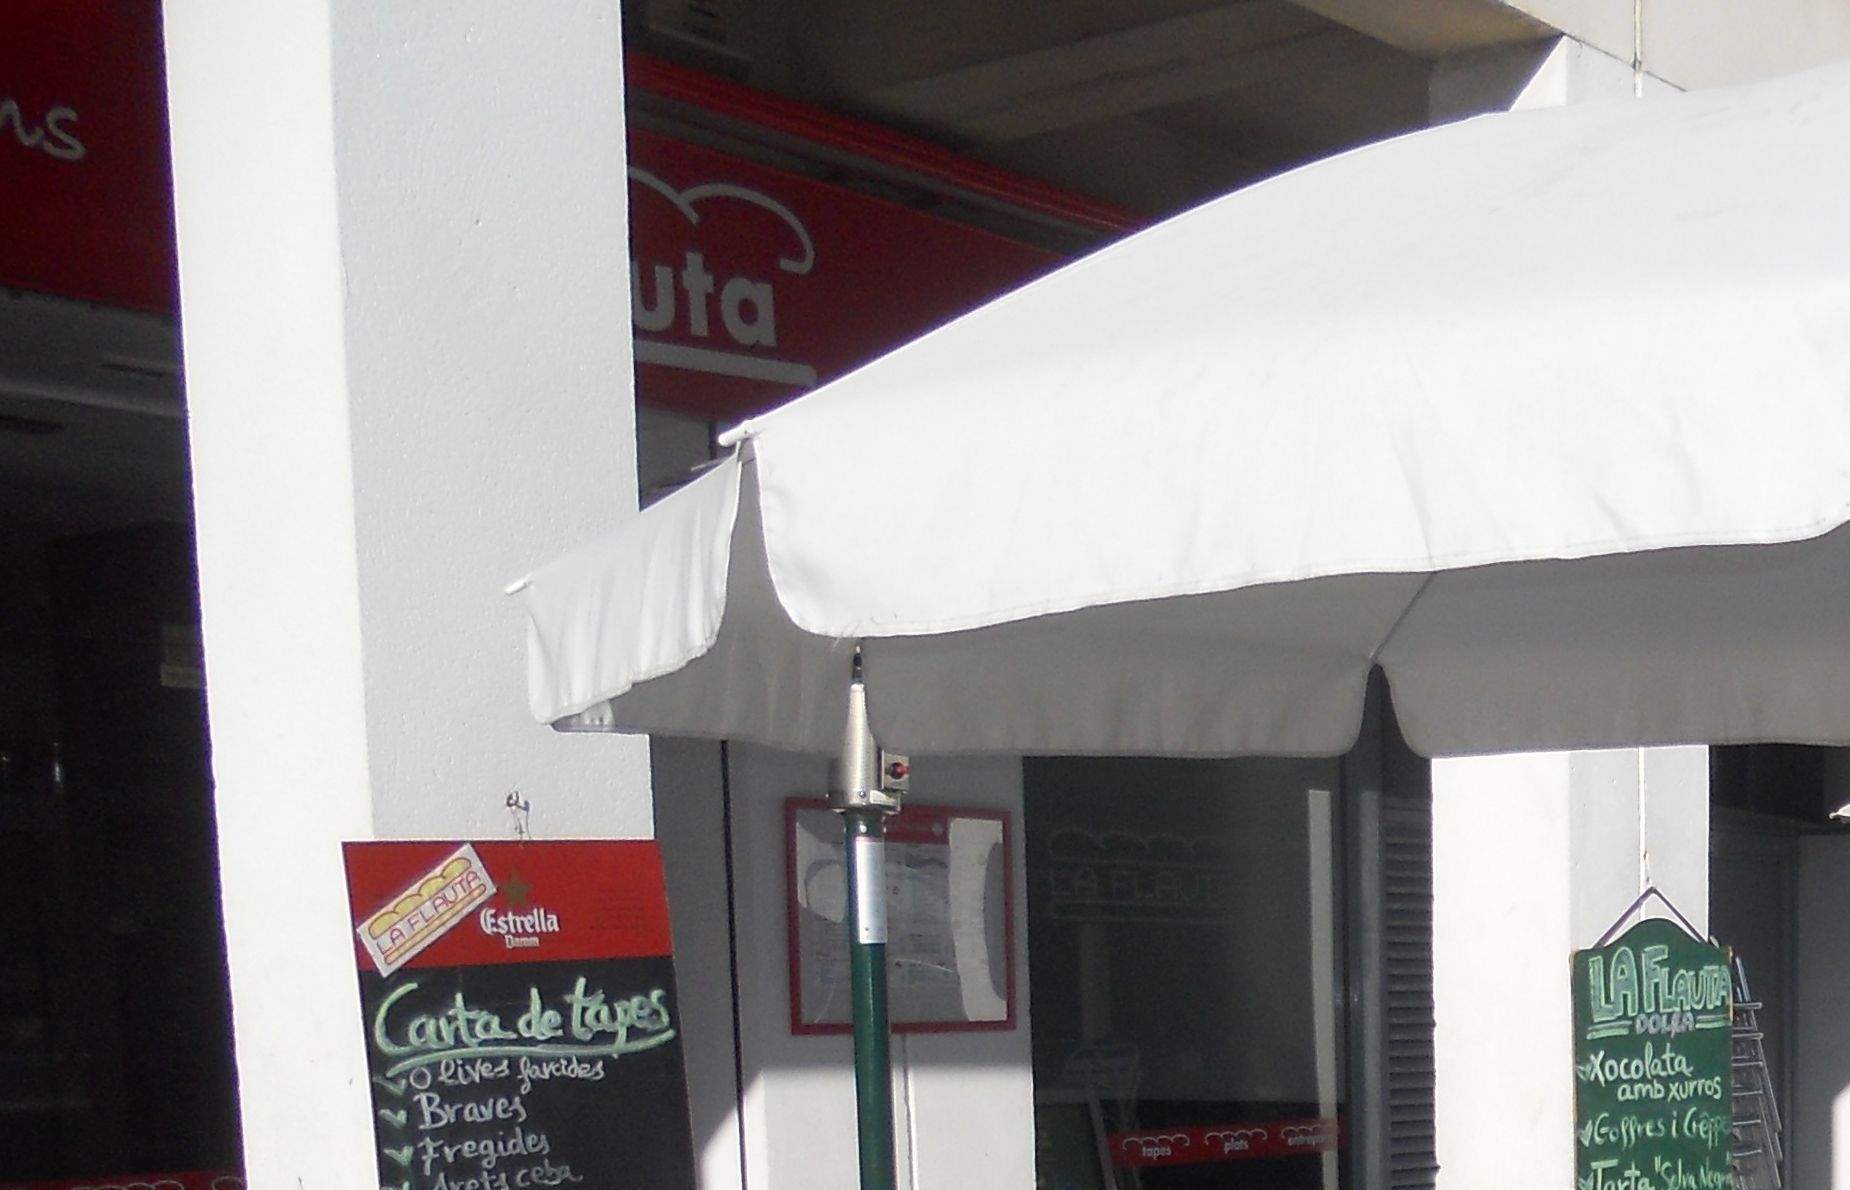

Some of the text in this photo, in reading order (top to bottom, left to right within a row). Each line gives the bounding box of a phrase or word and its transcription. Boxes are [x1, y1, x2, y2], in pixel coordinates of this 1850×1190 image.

[377, 870, 481, 955] LA FLAUTA
[480, 908, 559, 935] Estrella
[1588, 946, 1638, 1022] LA
[374, 976, 670, 1054] Carta de tapes
[518, 1057, 605, 1094] farcides
[1590, 1041, 1692, 1086] Xocolata
[1617, 1076, 1722, 1103] amb xurros
[413, 1091, 527, 1131] Braves
[1671, 1110, 1678, 1139] i
[418, 1127, 550, 1176] Fregides
[516, 1158, 583, 1188] ceba
